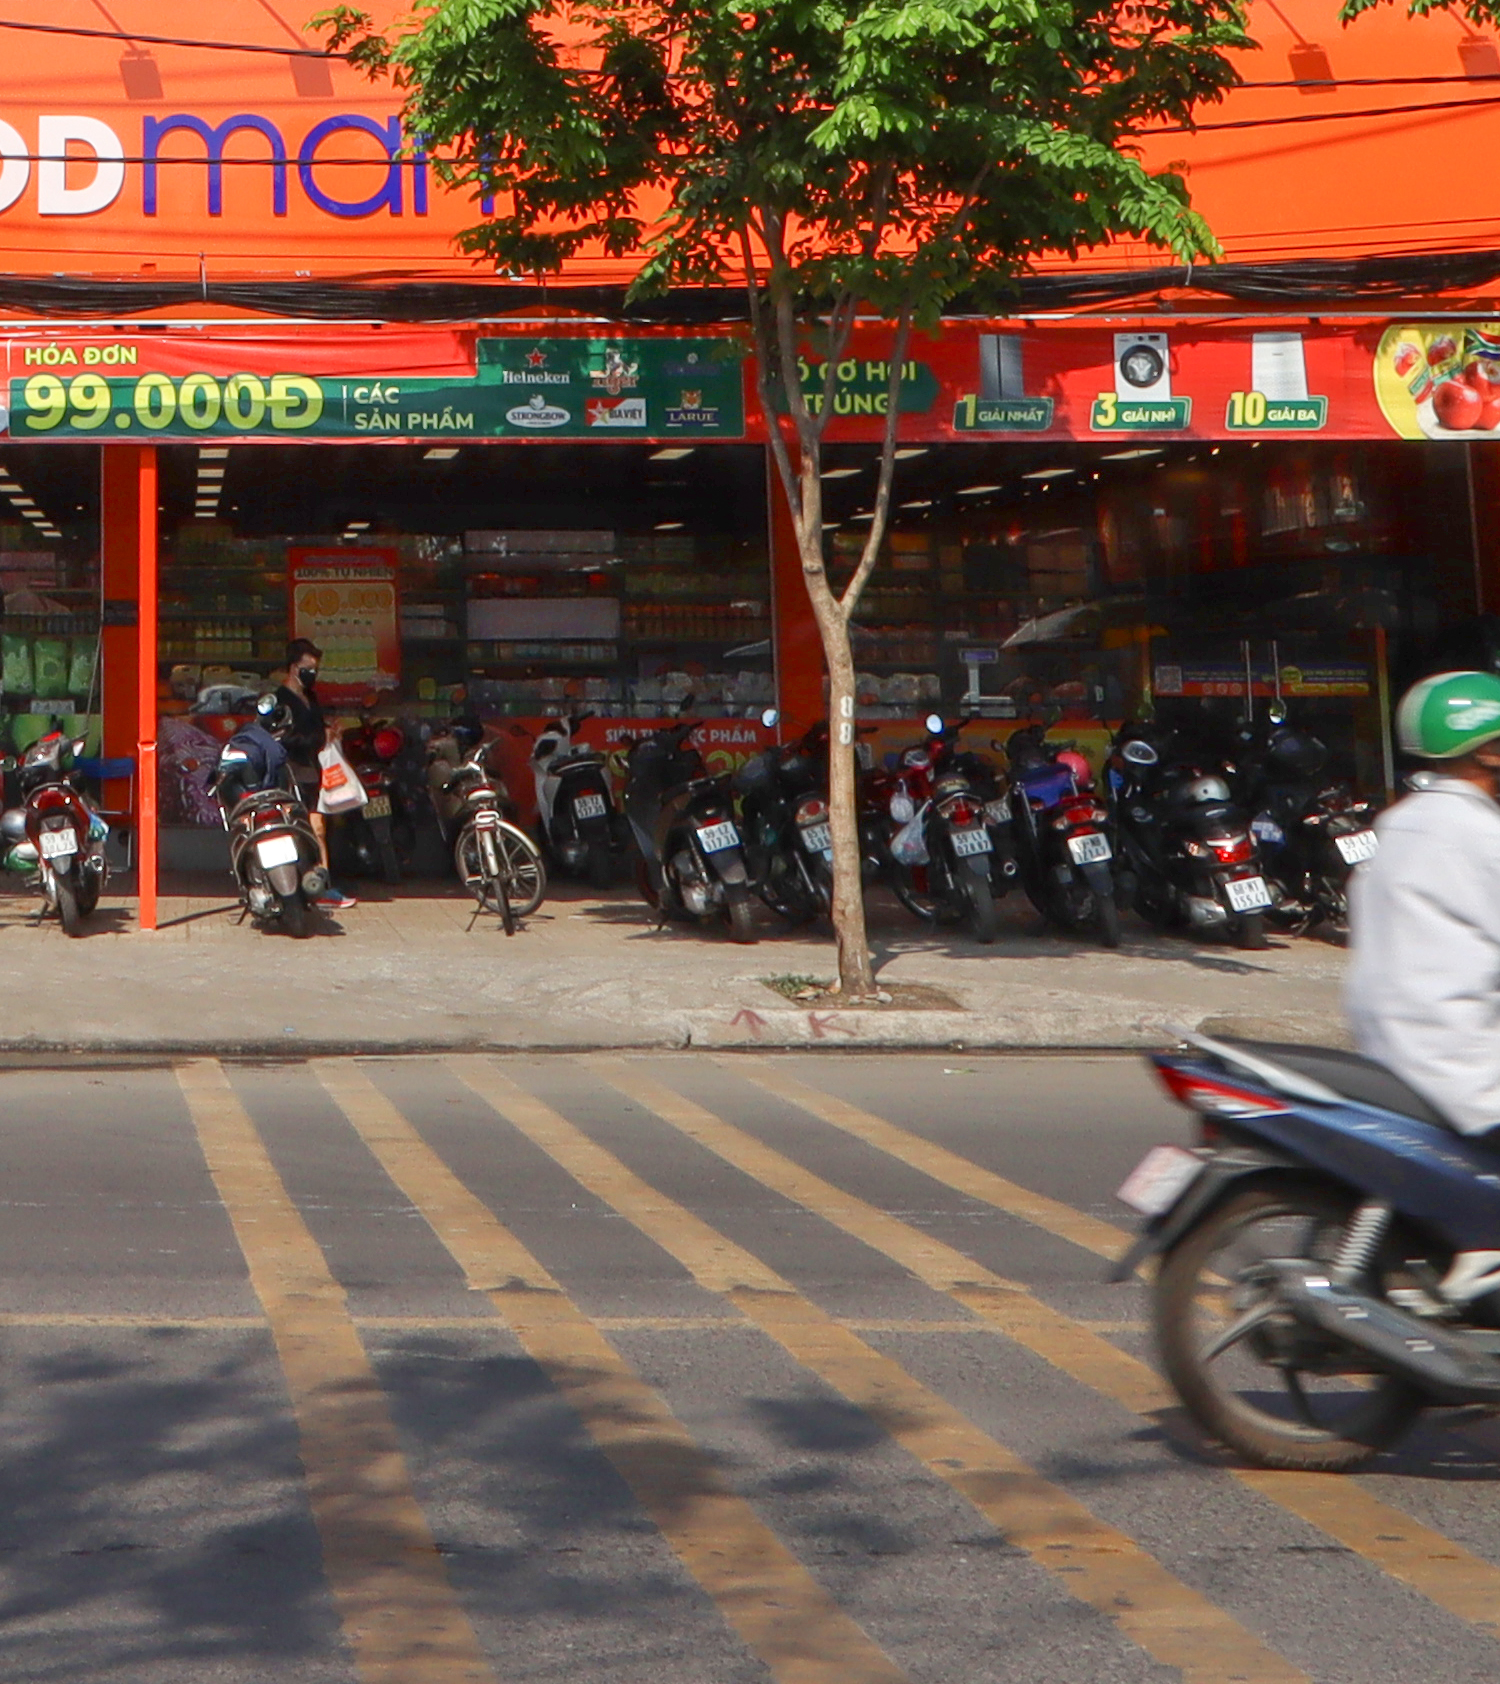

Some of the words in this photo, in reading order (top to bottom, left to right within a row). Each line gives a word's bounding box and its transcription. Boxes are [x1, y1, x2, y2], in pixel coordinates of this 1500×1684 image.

[24, 341, 78, 366] HÓA
[82, 344, 138, 366] ĐƠN
[502, 370, 571, 385] Heineken
[22, 371, 325, 432] 99.000Đ
[353, 384, 400, 406] CÁC
[354, 410, 402, 431] SẢN
[406, 405, 475, 431] PHẨM
[510, 409, 567, 422] STRONGBOW
[669, 411, 716, 423] LARUE
[960, 392, 978, 428] 1
[1096, 391, 1117, 427] 3
[1231, 391, 1265, 427] 10
